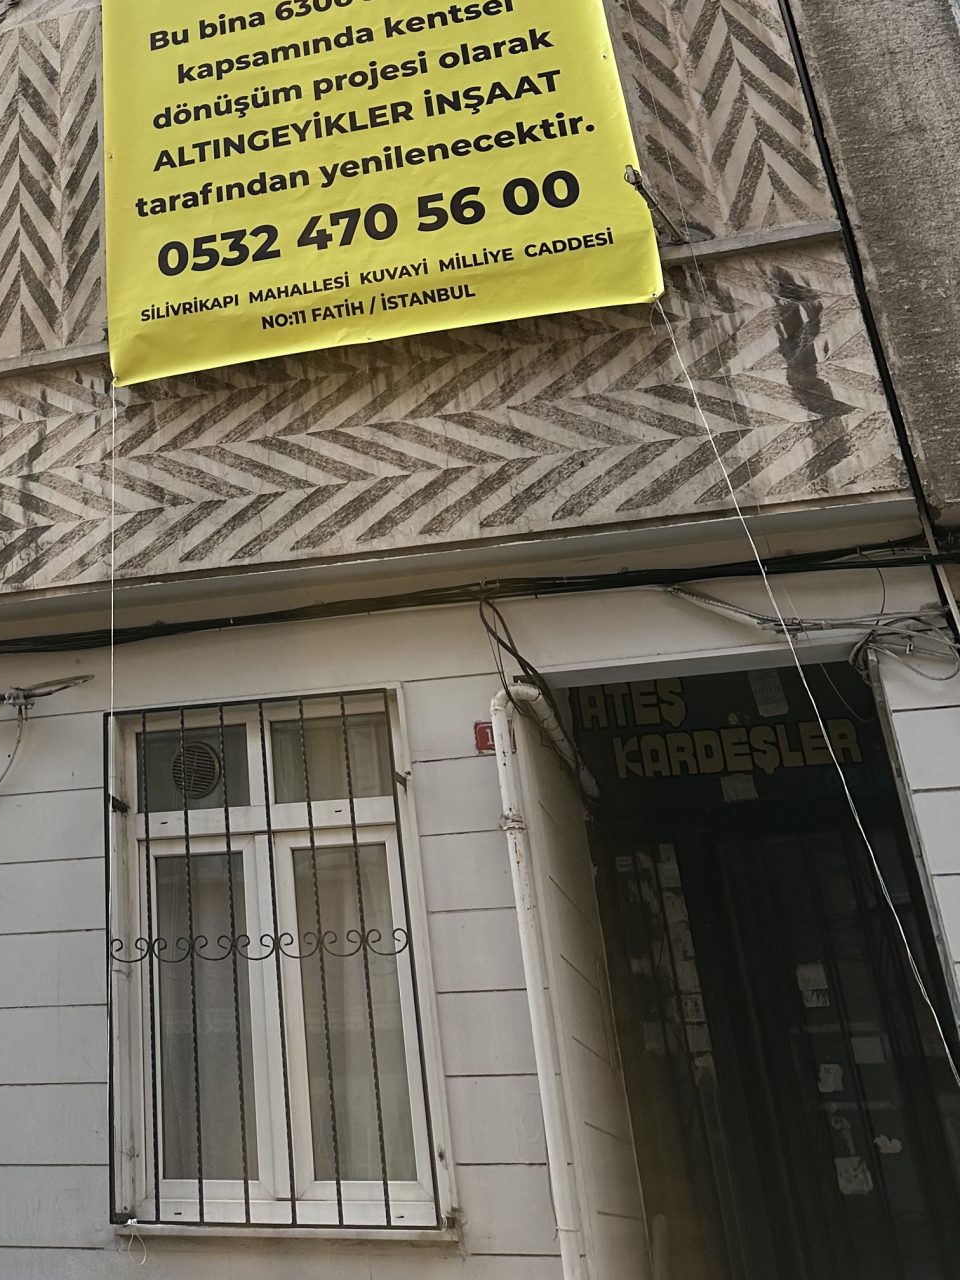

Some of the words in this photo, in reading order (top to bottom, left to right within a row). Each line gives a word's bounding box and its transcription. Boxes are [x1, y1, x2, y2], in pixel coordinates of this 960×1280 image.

[150, 29, 189, 51] Bu
[199, 12, 265, 40] bina
[178, 25, 374, 84] kapsamında
[153, 85, 302, 129] dönüşüm
[313, 51, 428, 101] projesi
[439, 28, 554, 69] olarak
[153, 101, 414, 172] ALTINGEYİKLER
[424, 69, 561, 117] İNŞAAT
[135, 170, 309, 217] tarafından
[319, 112, 595, 188] yenilenecektir.
[158, 224, 281, 276] 0532
[297, 203, 398, 250] 470
[417, 186, 485, 232] 56
[503, 170, 580, 215] 00
[141, 294, 239, 322] SİLİVRİKAPI
[249, 271, 349, 304] MAHALLESİ
[360, 258, 428, 285] KUVAYİ
[439, 248, 514, 272] MİLLİYE
[524, 227, 614, 257] CADDESİ
[261, 310, 307, 330] NO:11
[311, 298, 364, 322] FATİH
[380, 284, 476, 311] İSTANBUL
[580, 677, 686, 728] ATEŞ
[614, 720, 863, 780] KARDEŞLER
